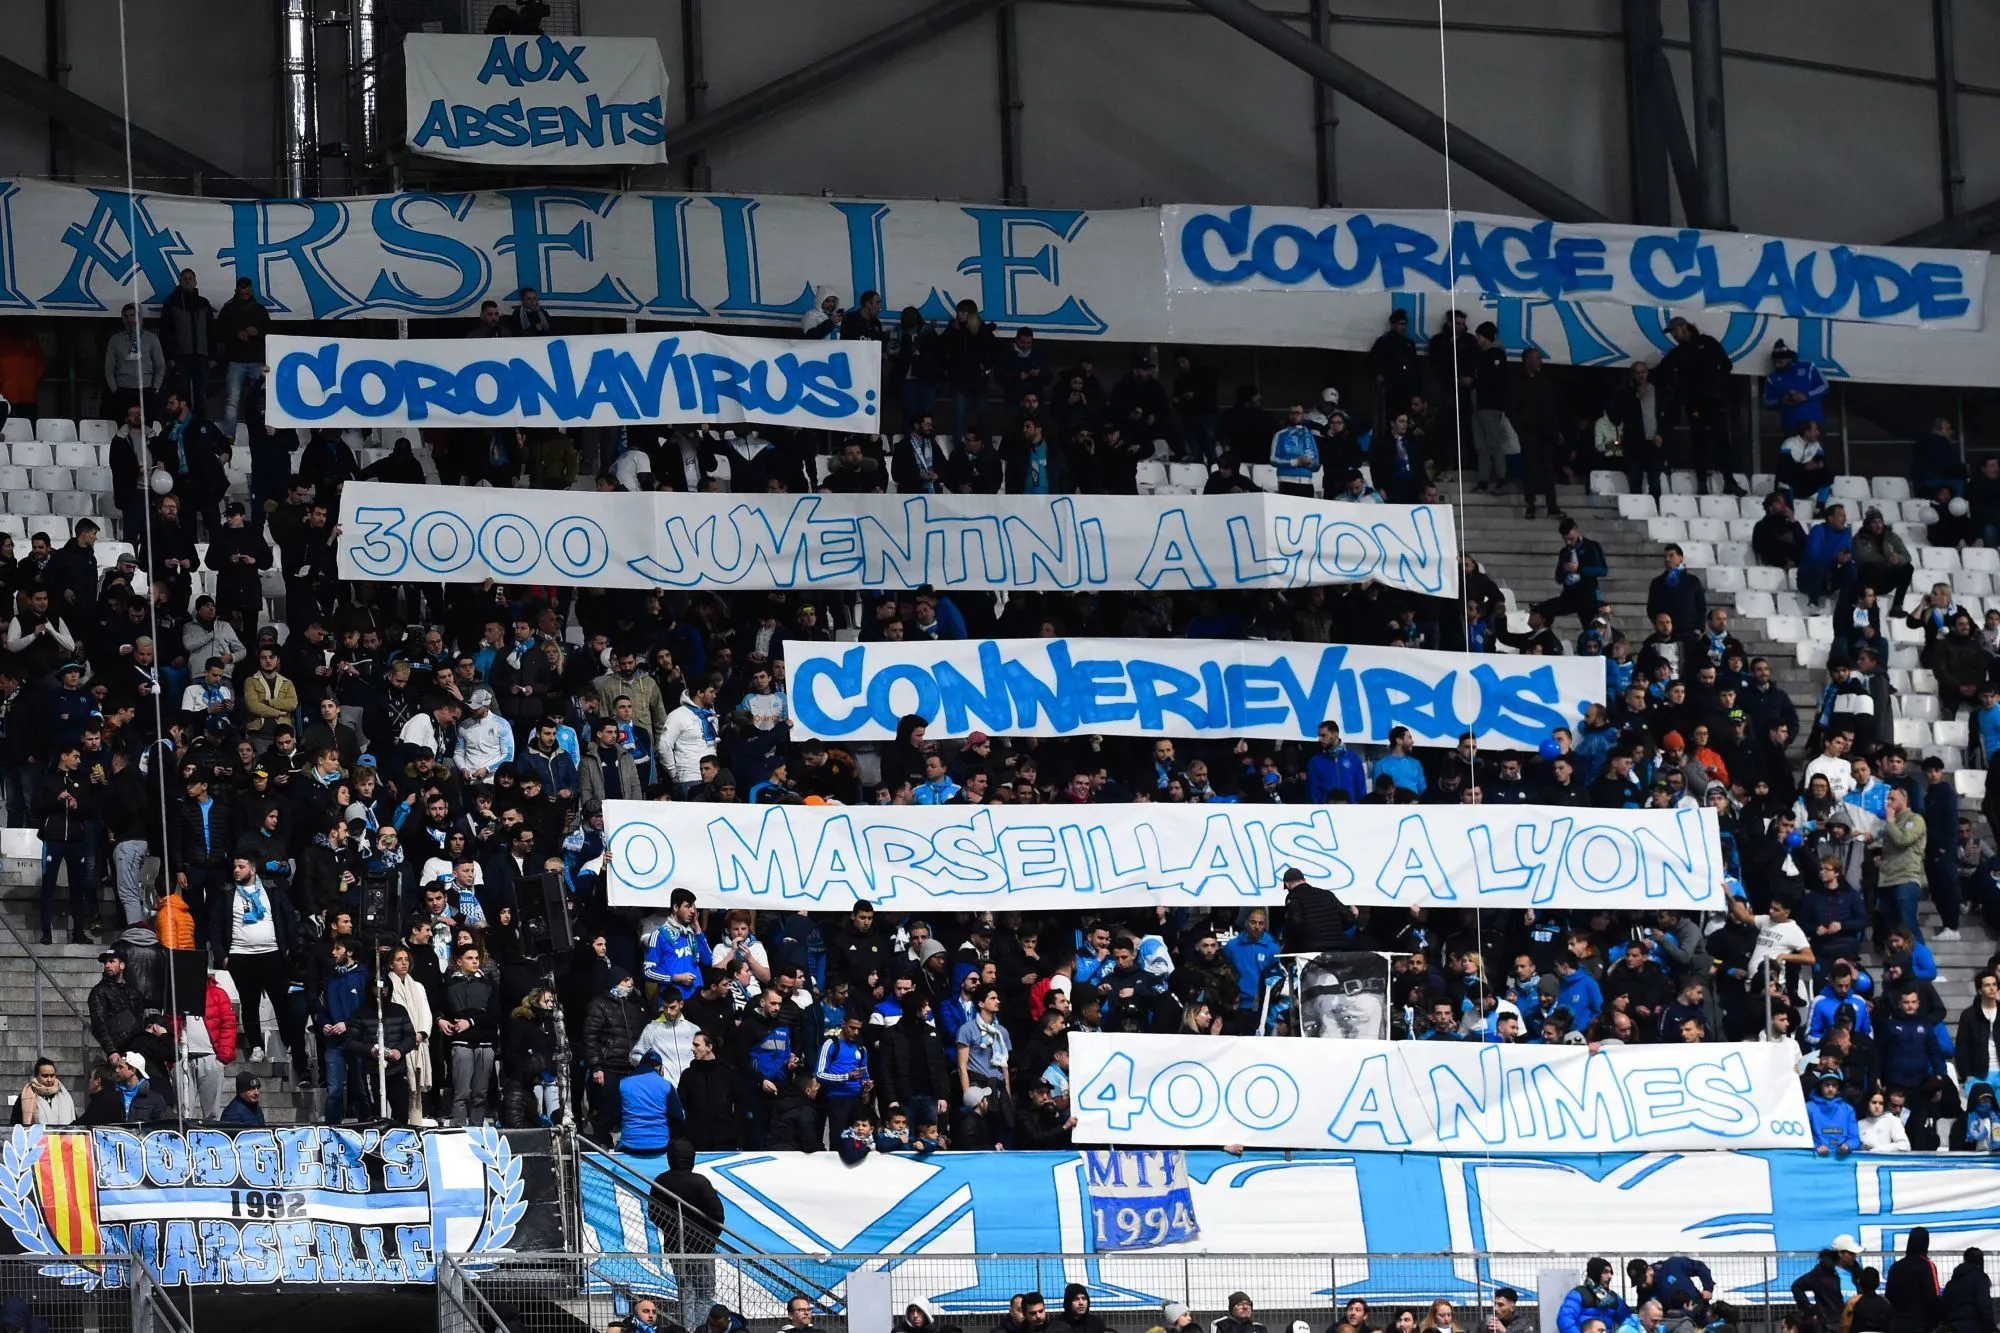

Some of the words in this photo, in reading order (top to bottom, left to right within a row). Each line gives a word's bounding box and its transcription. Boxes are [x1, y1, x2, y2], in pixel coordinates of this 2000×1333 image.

[476, 35, 589, 88] AUX
[413, 93, 666, 149] ABSENTS
[1180, 204, 1614, 300] COURAGE
[1630, 228, 1971, 321] CLAUDE
[275, 336, 876, 422] CORONAVIRUS:
[349, 506, 609, 577] 3000
[626, 496, 1108, 589] JUVENTINI
[1136, 508, 1216, 590] A
[1226, 505, 1443, 592] LYON
[706, 805, 1355, 905] MARSEILLAIS
[1375, 813, 1458, 899] A
[1467, 807, 1712, 904] LYON
[1078, 1051, 1301, 1132] 400
[1327, 1053, 1412, 1147] A
[93, 1126, 428, 1192] DODGER'S
[230, 1190, 308, 1219] 1992
[1093, 1201, 1197, 1246] 1994
[99, 1219, 438, 1288] MARSEILLE
